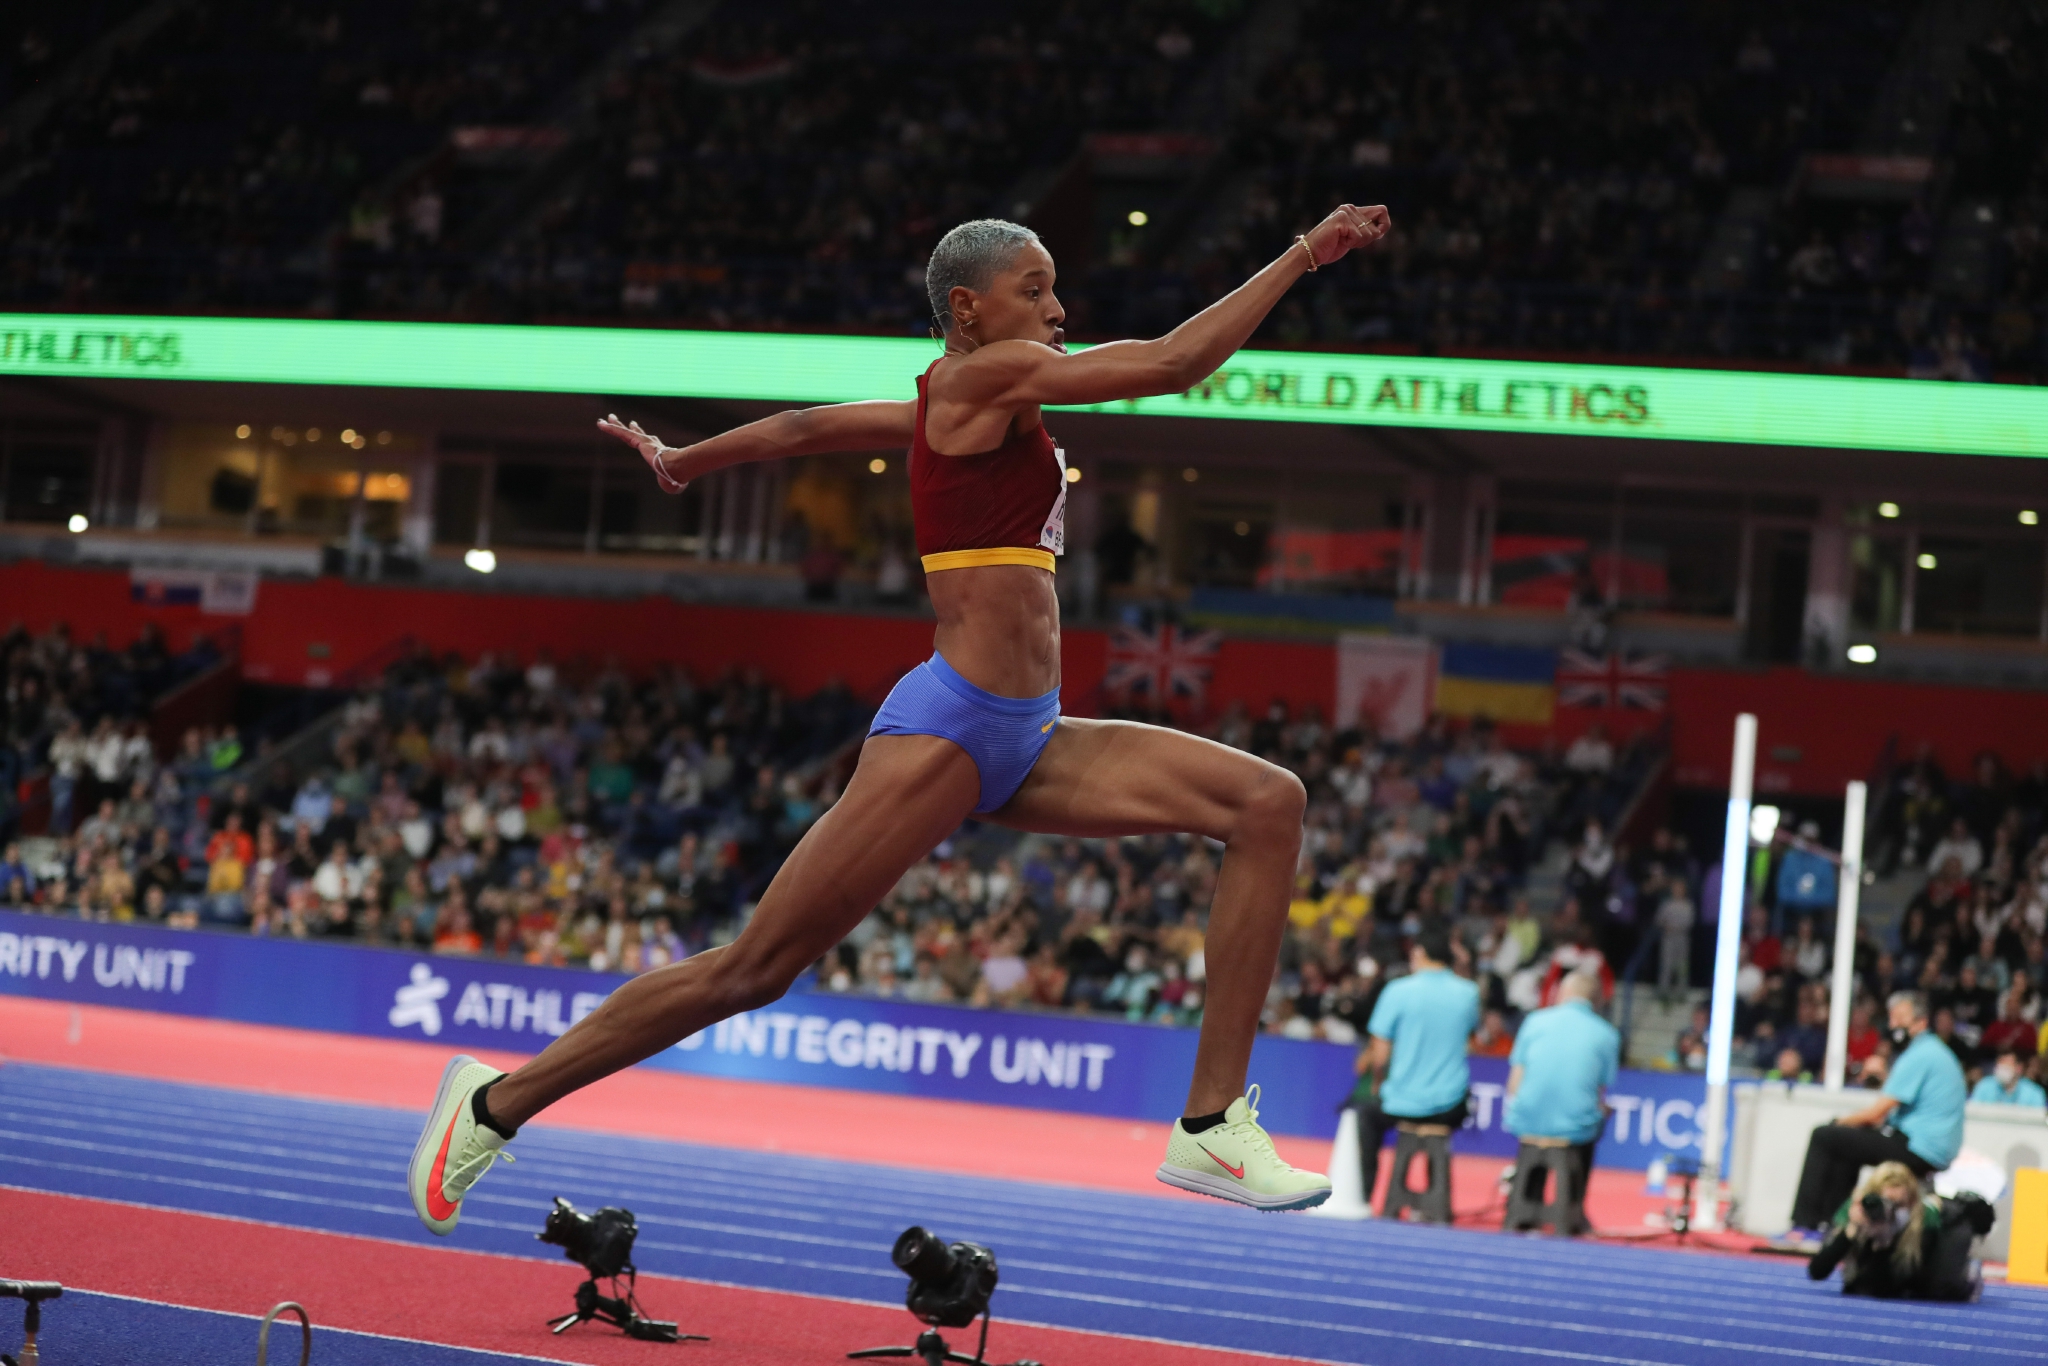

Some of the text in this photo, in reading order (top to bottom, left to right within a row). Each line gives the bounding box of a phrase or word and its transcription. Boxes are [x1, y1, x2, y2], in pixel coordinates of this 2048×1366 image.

[1371, 374, 1650, 425] ATHLETICS
[94, 942, 195, 995] UNIT
[714, 1011, 982, 1079] INTEGRITY
[990, 1035, 1116, 1092] UNIT
